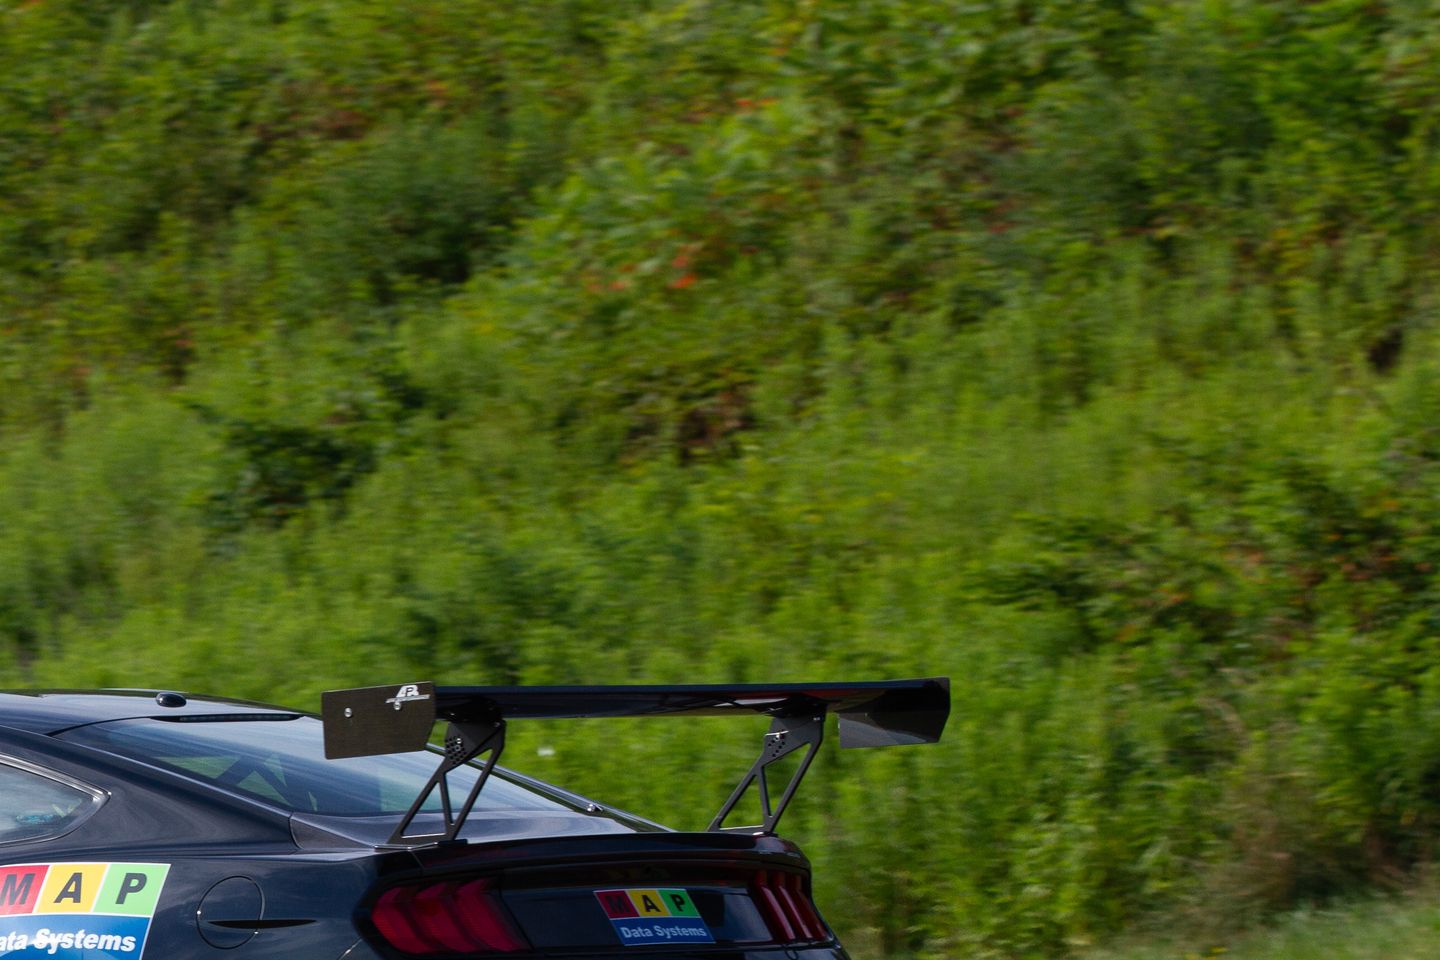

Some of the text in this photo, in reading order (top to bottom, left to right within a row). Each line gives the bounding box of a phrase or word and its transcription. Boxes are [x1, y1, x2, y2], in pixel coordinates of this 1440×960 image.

[30, 928, 137, 955] Systems
[620, 924, 708, 939] Data Systems
